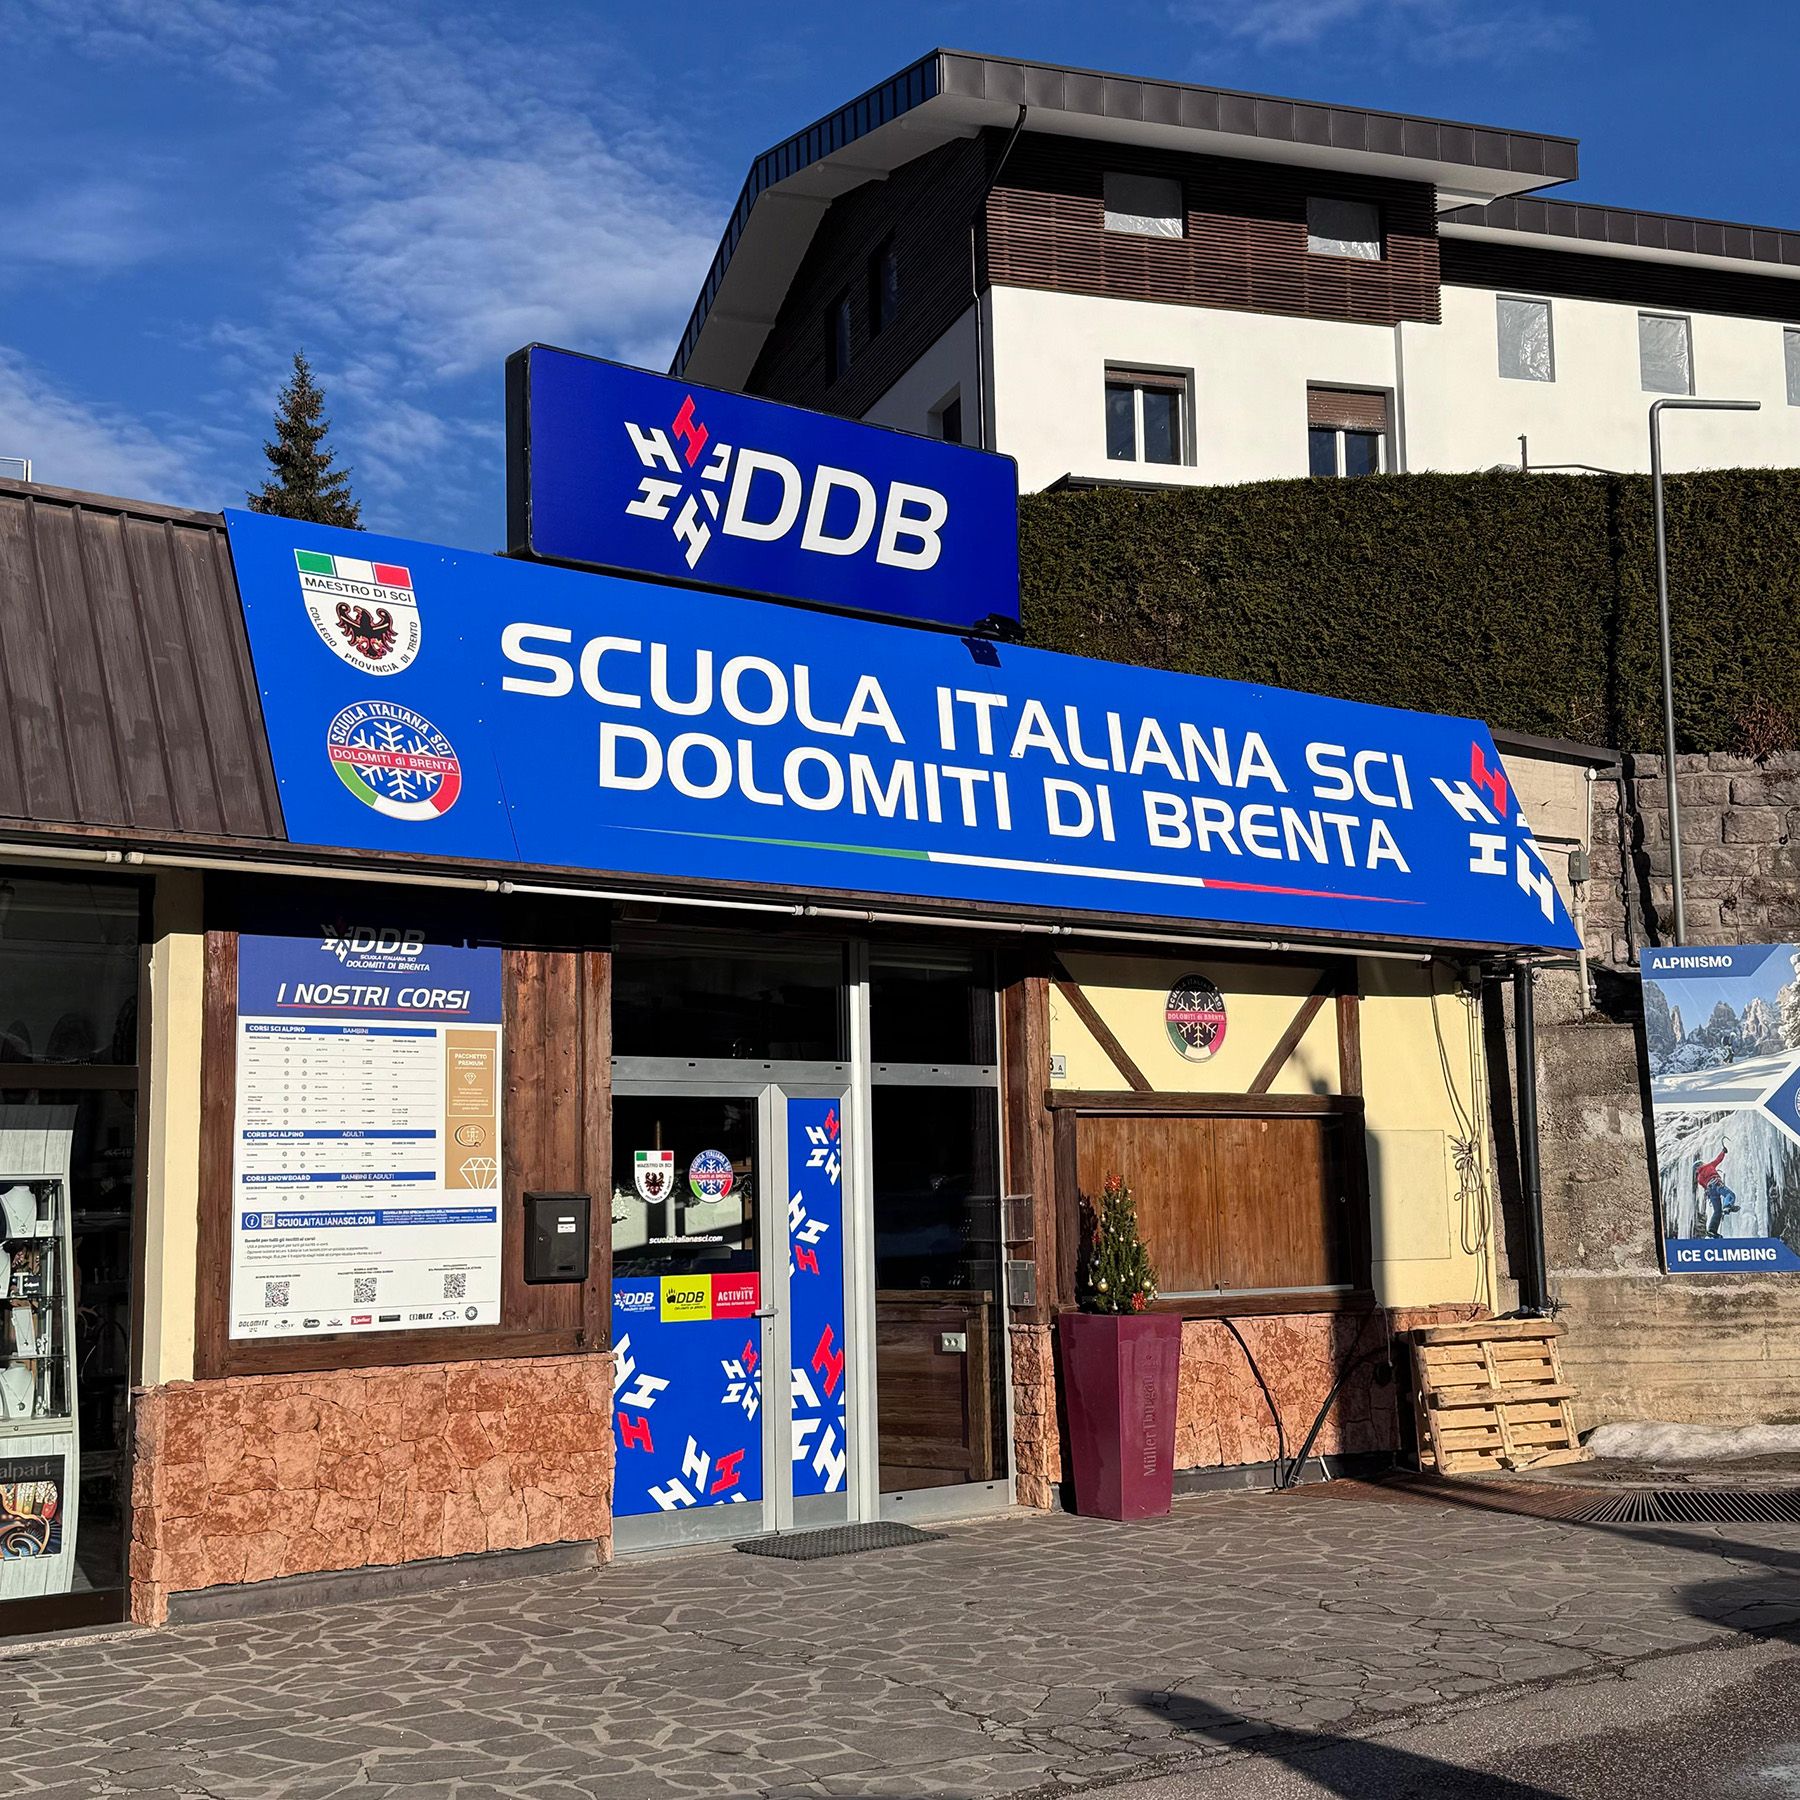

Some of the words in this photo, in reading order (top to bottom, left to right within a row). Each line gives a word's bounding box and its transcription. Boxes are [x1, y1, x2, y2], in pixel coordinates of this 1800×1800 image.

[722, 448, 948, 570] DDB
[305, 577, 370, 596] MAESTRO
[373, 588, 387, 598] DI
[390, 591, 411, 602] SCI
[309, 606, 338, 647] COLLEGIO
[344, 653, 399, 673] PROVINCIA
[400, 654, 411, 664] DI
[407, 621, 418, 653] TRENTO
[501, 622, 905, 744] SCUOLA
[936, 686, 1288, 793] ITALIANA
[1305, 742, 1414, 811] SCI
[331, 705, 368, 744] SCUOLA
[368, 703, 430, 734] ITALIANA
[430, 734, 451, 755] SCI
[333, 749, 391, 763] DOLOMITI
[395, 756, 406, 766] di
[410, 758, 456, 771] BRENTA
[600, 722, 1011, 831] DOLOMITI
[1043, 778, 1116, 842] DI
[1143, 791, 1411, 873] BRENTA
[350, 927, 426, 956] DDB
[346, 960, 385, 970] DOLOMITI
[387, 961, 396, 970] DI
[398, 962, 430, 972] BRENTA
[1652, 956, 1733, 969] ALPINISMO
[277, 983, 287, 1003] I
[294, 984, 390, 1006] NOSTRI
[397, 988, 471, 1009] CORSI
[1167, 1012, 1196, 1020] DOLOMITI
[1204, 1013, 1225, 1021] BRENTA
[267, 1174, 311, 1182] SNOWBOARD
[277, 1216, 376, 1227] SCUOLAITALIANASCI.COM
[1677, 1250, 1702, 1262] ICE
[1704, 1248, 1777, 1261] CLIMBING
[625, 1292, 655, 1304] DDB
[676, 1291, 705, 1303] DDB
[718, 1290, 754, 1301] ACTIVITY
[238, 1319, 269, 1327] DOLOMITE
[418, 1312, 433, 1320] BLIZ
[1143, 1433, 1157, 1477] Müller
